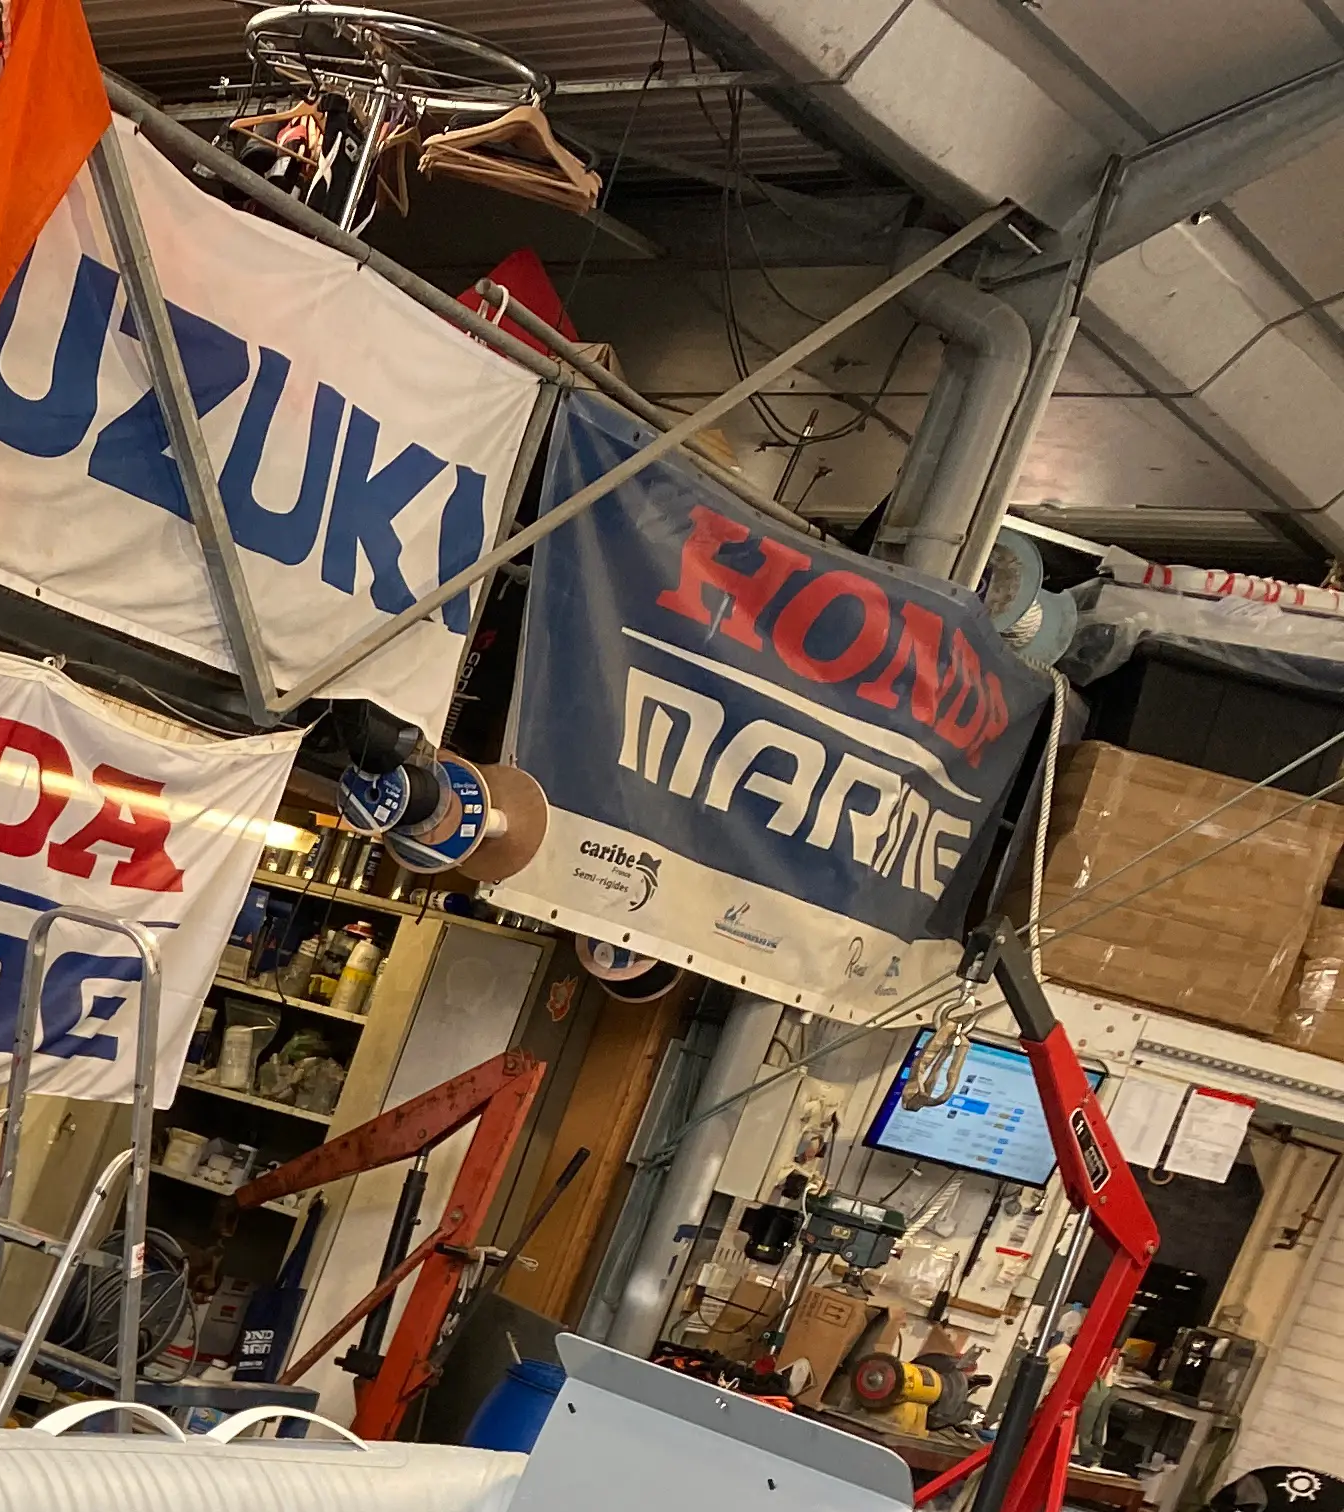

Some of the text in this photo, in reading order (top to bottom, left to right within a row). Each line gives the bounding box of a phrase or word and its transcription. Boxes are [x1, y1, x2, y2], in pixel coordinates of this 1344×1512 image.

[618, 667, 972, 901] MARINE
[580, 840, 636, 868] caribe
[573, 868, 630, 893] Semi-rigides
